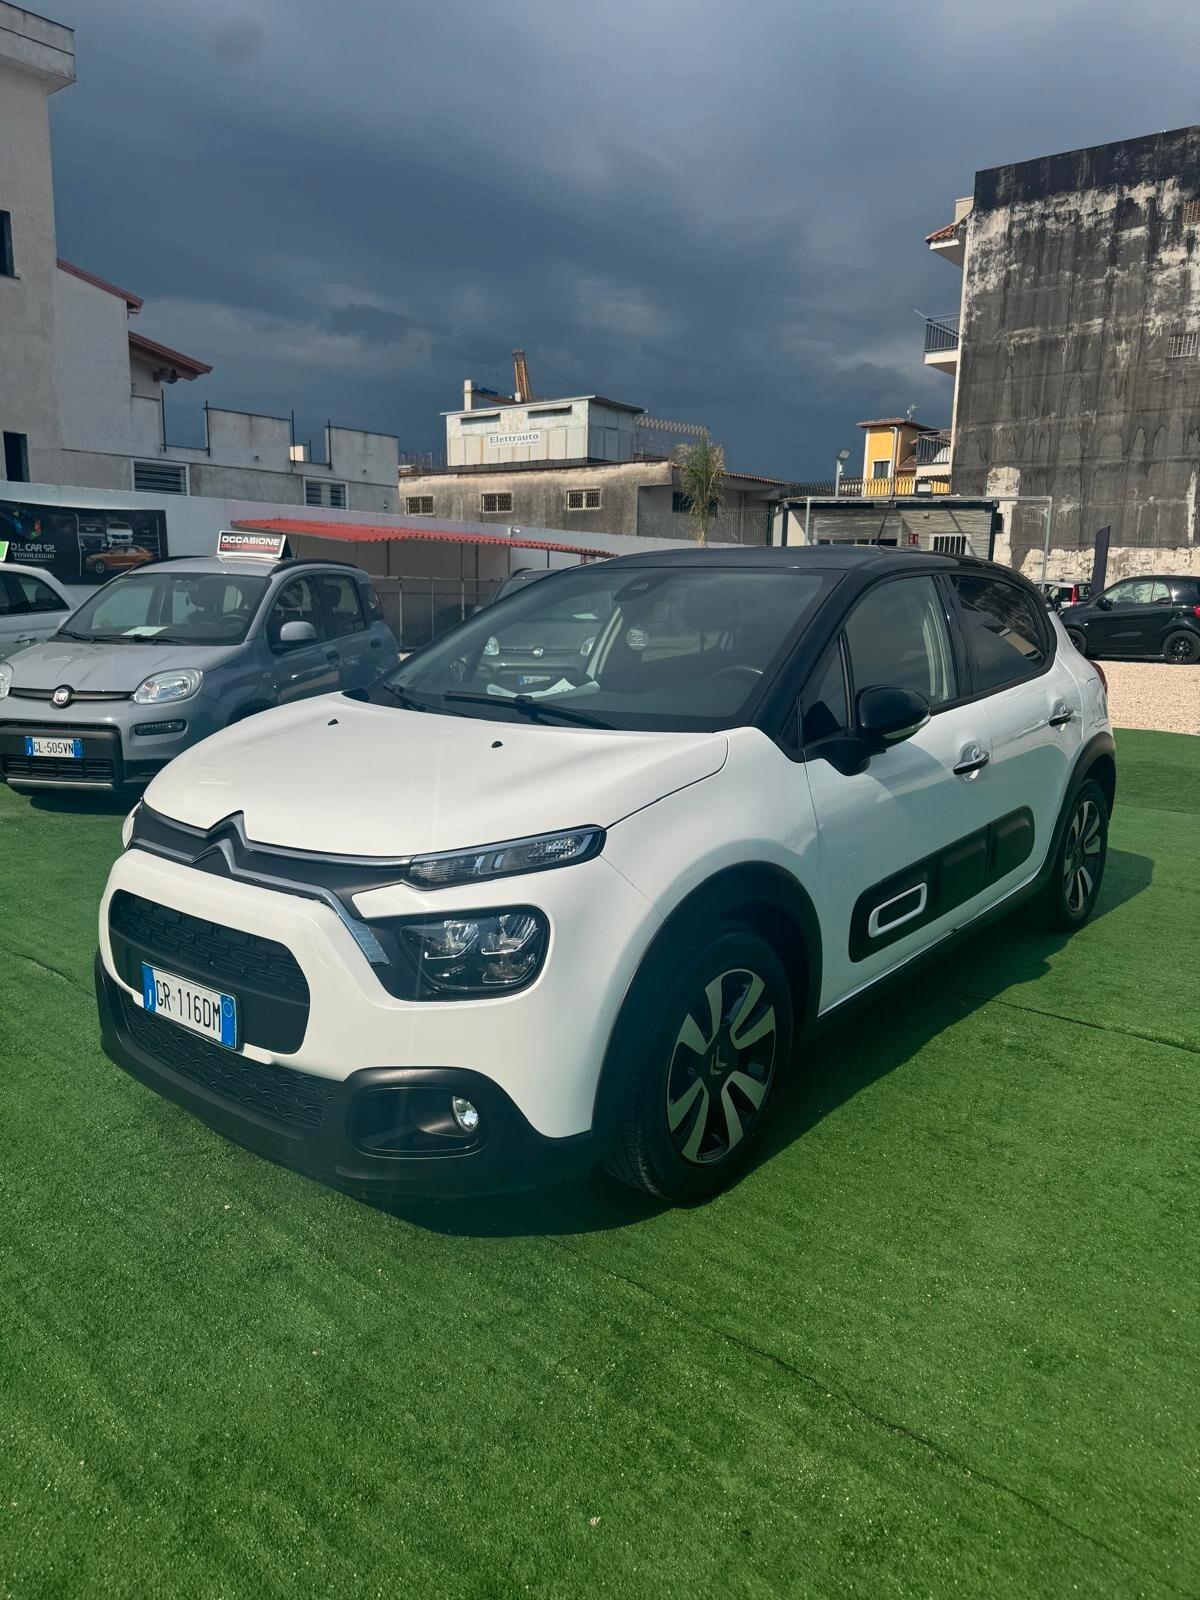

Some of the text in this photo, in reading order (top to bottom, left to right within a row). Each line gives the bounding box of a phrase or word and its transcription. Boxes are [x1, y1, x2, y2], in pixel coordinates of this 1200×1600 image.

[490, 434, 539, 443] Elettrauto
[221, 535, 280, 546] OCCASIONE
[25, 543, 42, 552] CAR
